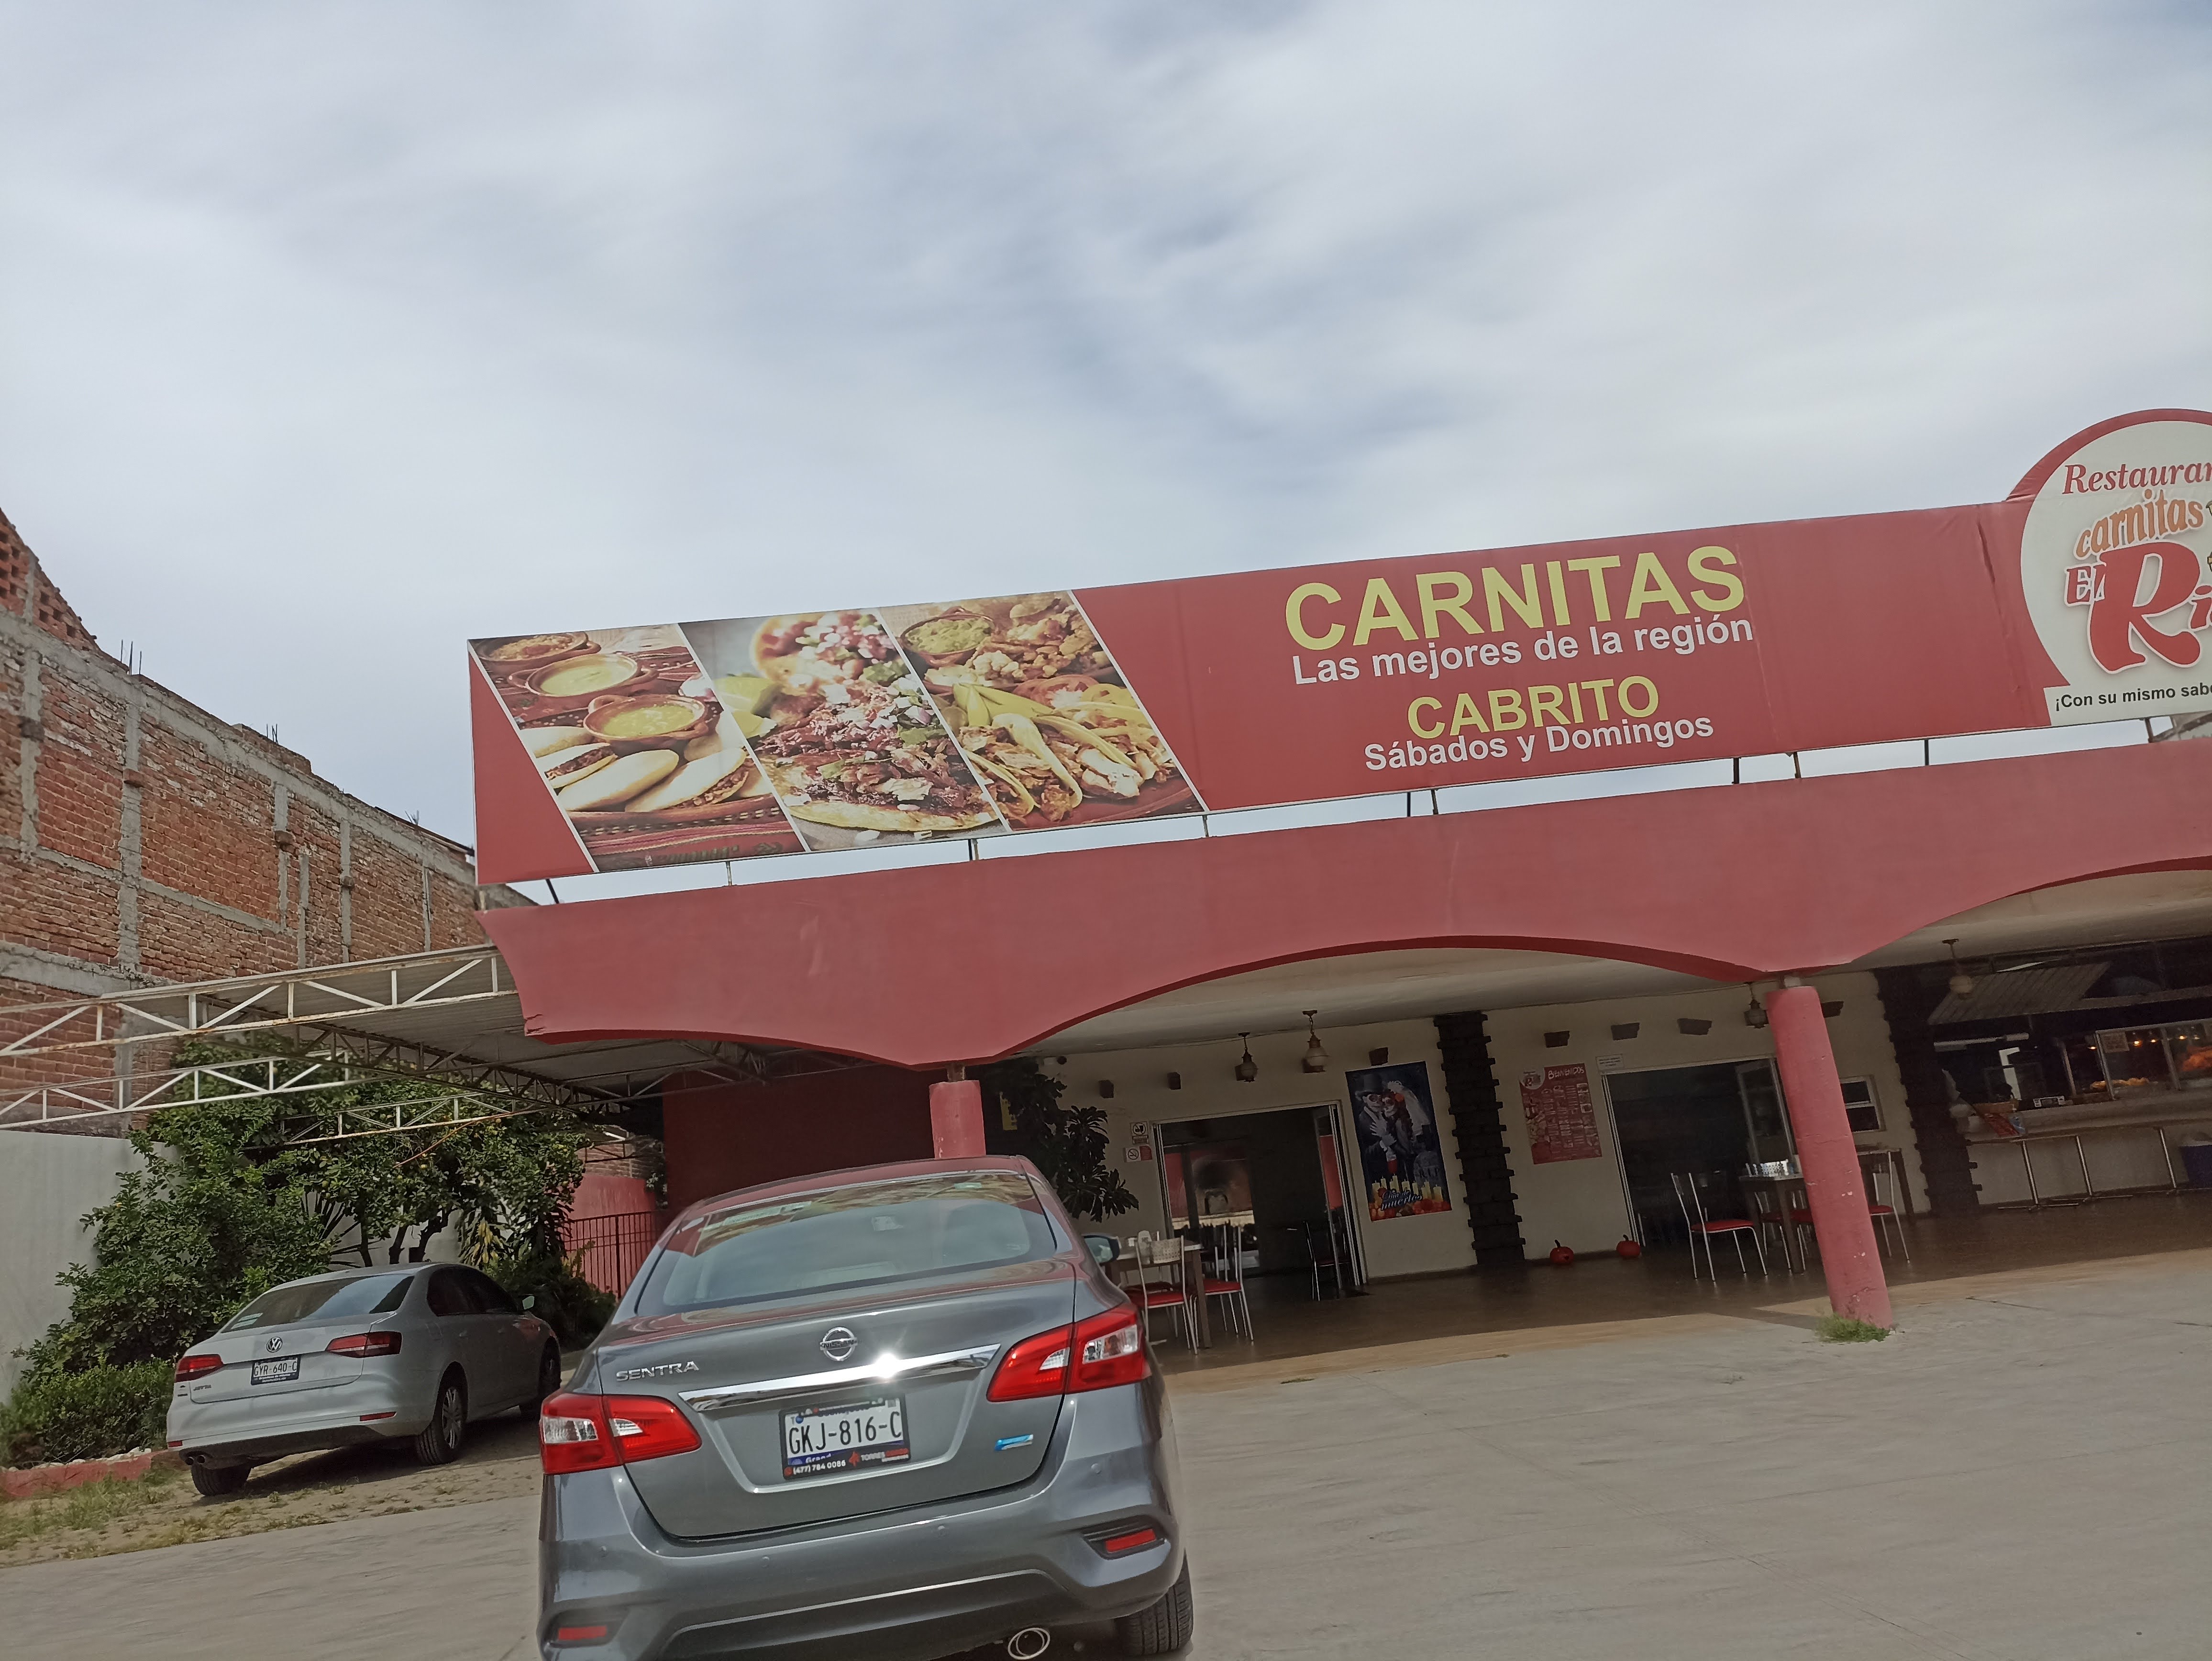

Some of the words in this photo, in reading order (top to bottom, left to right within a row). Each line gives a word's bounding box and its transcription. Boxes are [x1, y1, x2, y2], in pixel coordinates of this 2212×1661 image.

[2076, 488, 2203, 559] carnitas
[1285, 545, 1745, 650] CARNITAS
[2090, 541, 2212, 672] Ri
[1293, 655, 1360, 685] Las
[1371, 640, 1520, 679] mejores
[1534, 630, 1579, 661] de
[1589, 626, 1623, 655] la
[1634, 613, 1753, 655] región
[1407, 675, 1659, 739] CABRITO
[2056, 694, 2093, 711] ¡Con
[2098, 692, 2116, 704] su
[2122, 687, 2176, 703] mismo
[2180, 682, 2212, 697] sab
[1364, 732, 1508, 771] Sábados
[1517, 733, 1536, 762] y
[1546, 716, 1714, 752] Domingos
[254, 1361, 297, 1376] GYR-640-C
[616, 1361, 699, 1382] SENTRA
[789, 1411, 902, 1455] GKJ-816-C
